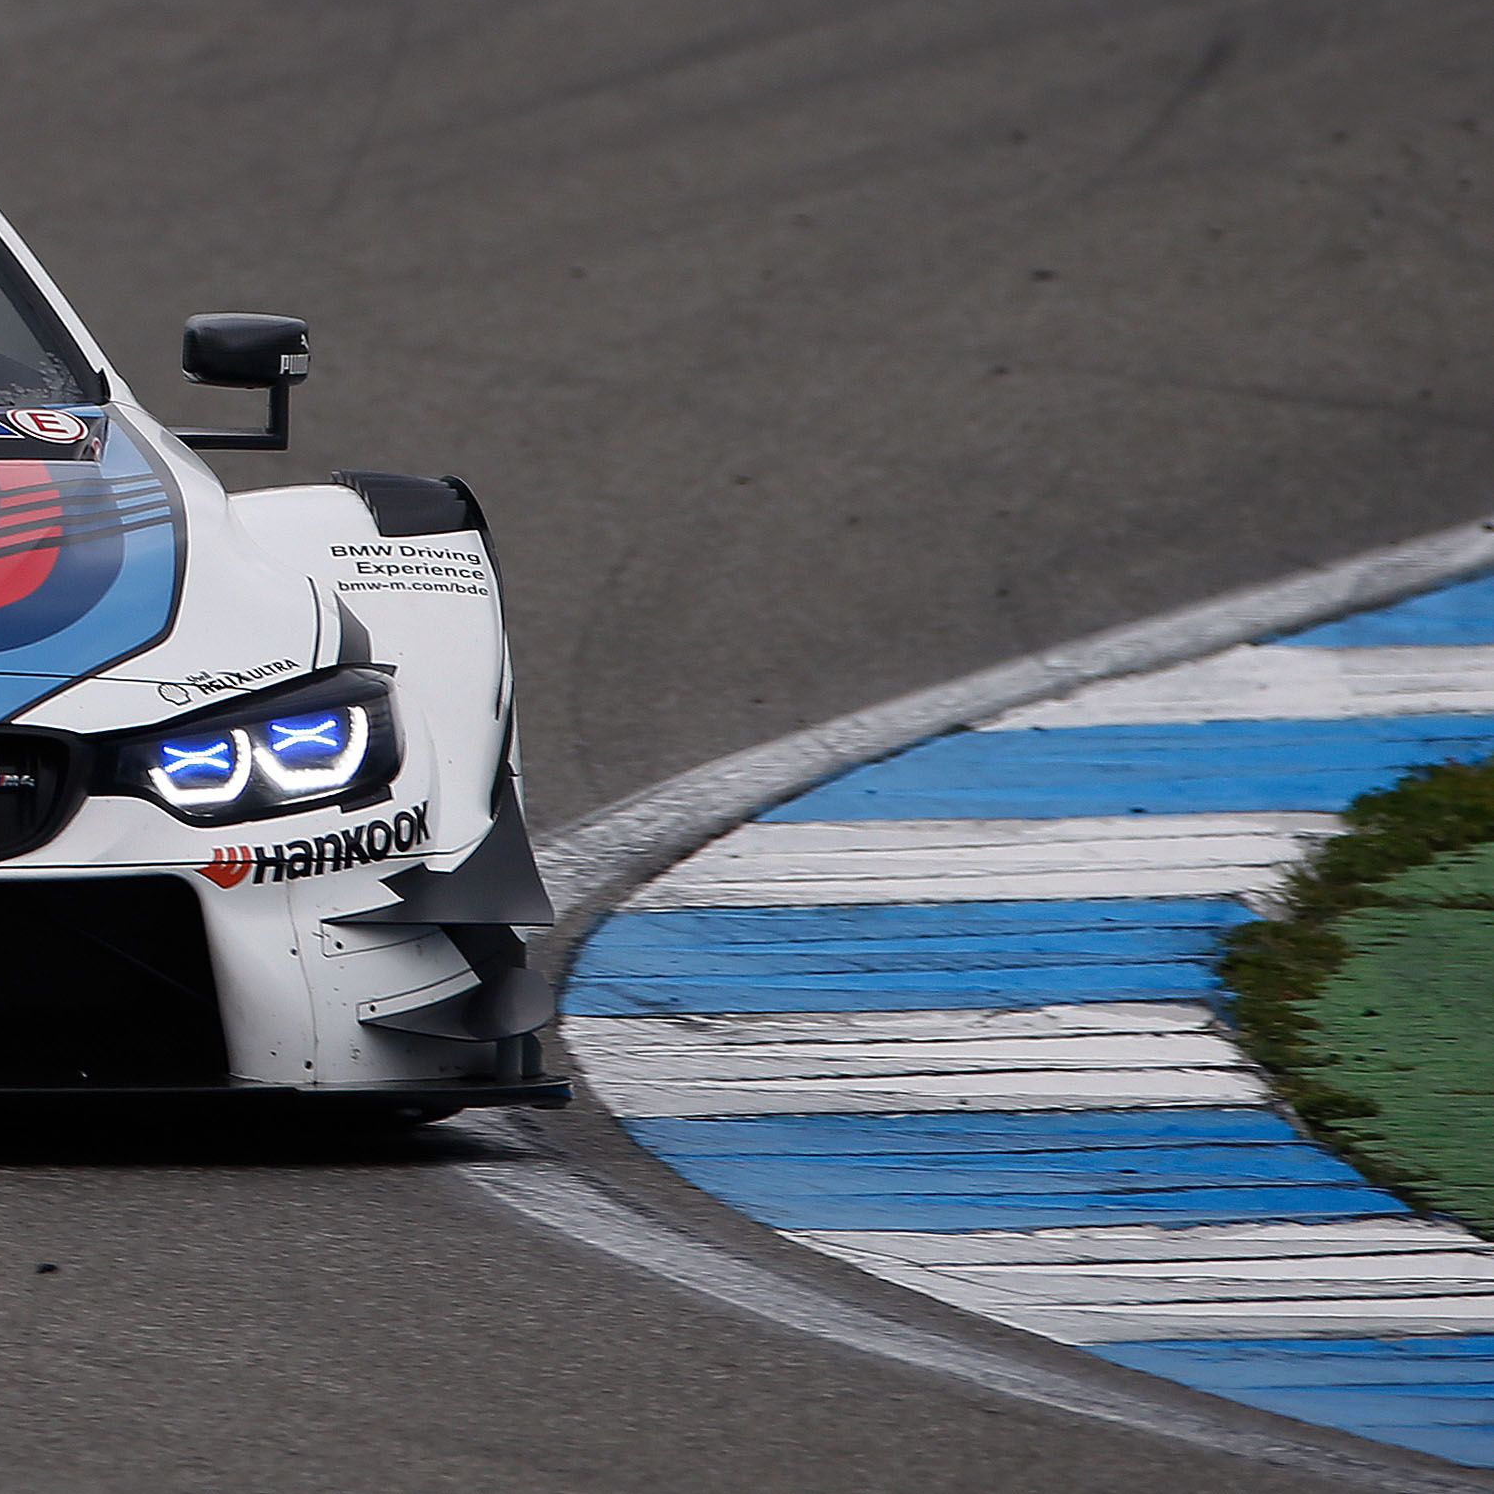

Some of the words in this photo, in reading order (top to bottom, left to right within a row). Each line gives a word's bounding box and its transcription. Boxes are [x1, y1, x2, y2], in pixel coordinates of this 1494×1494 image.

[330, 545, 393, 557] BMW
[398, 545, 482, 565] Driving
[356, 561, 486, 580] Experience
[246, 658, 301, 681] ULTRA
